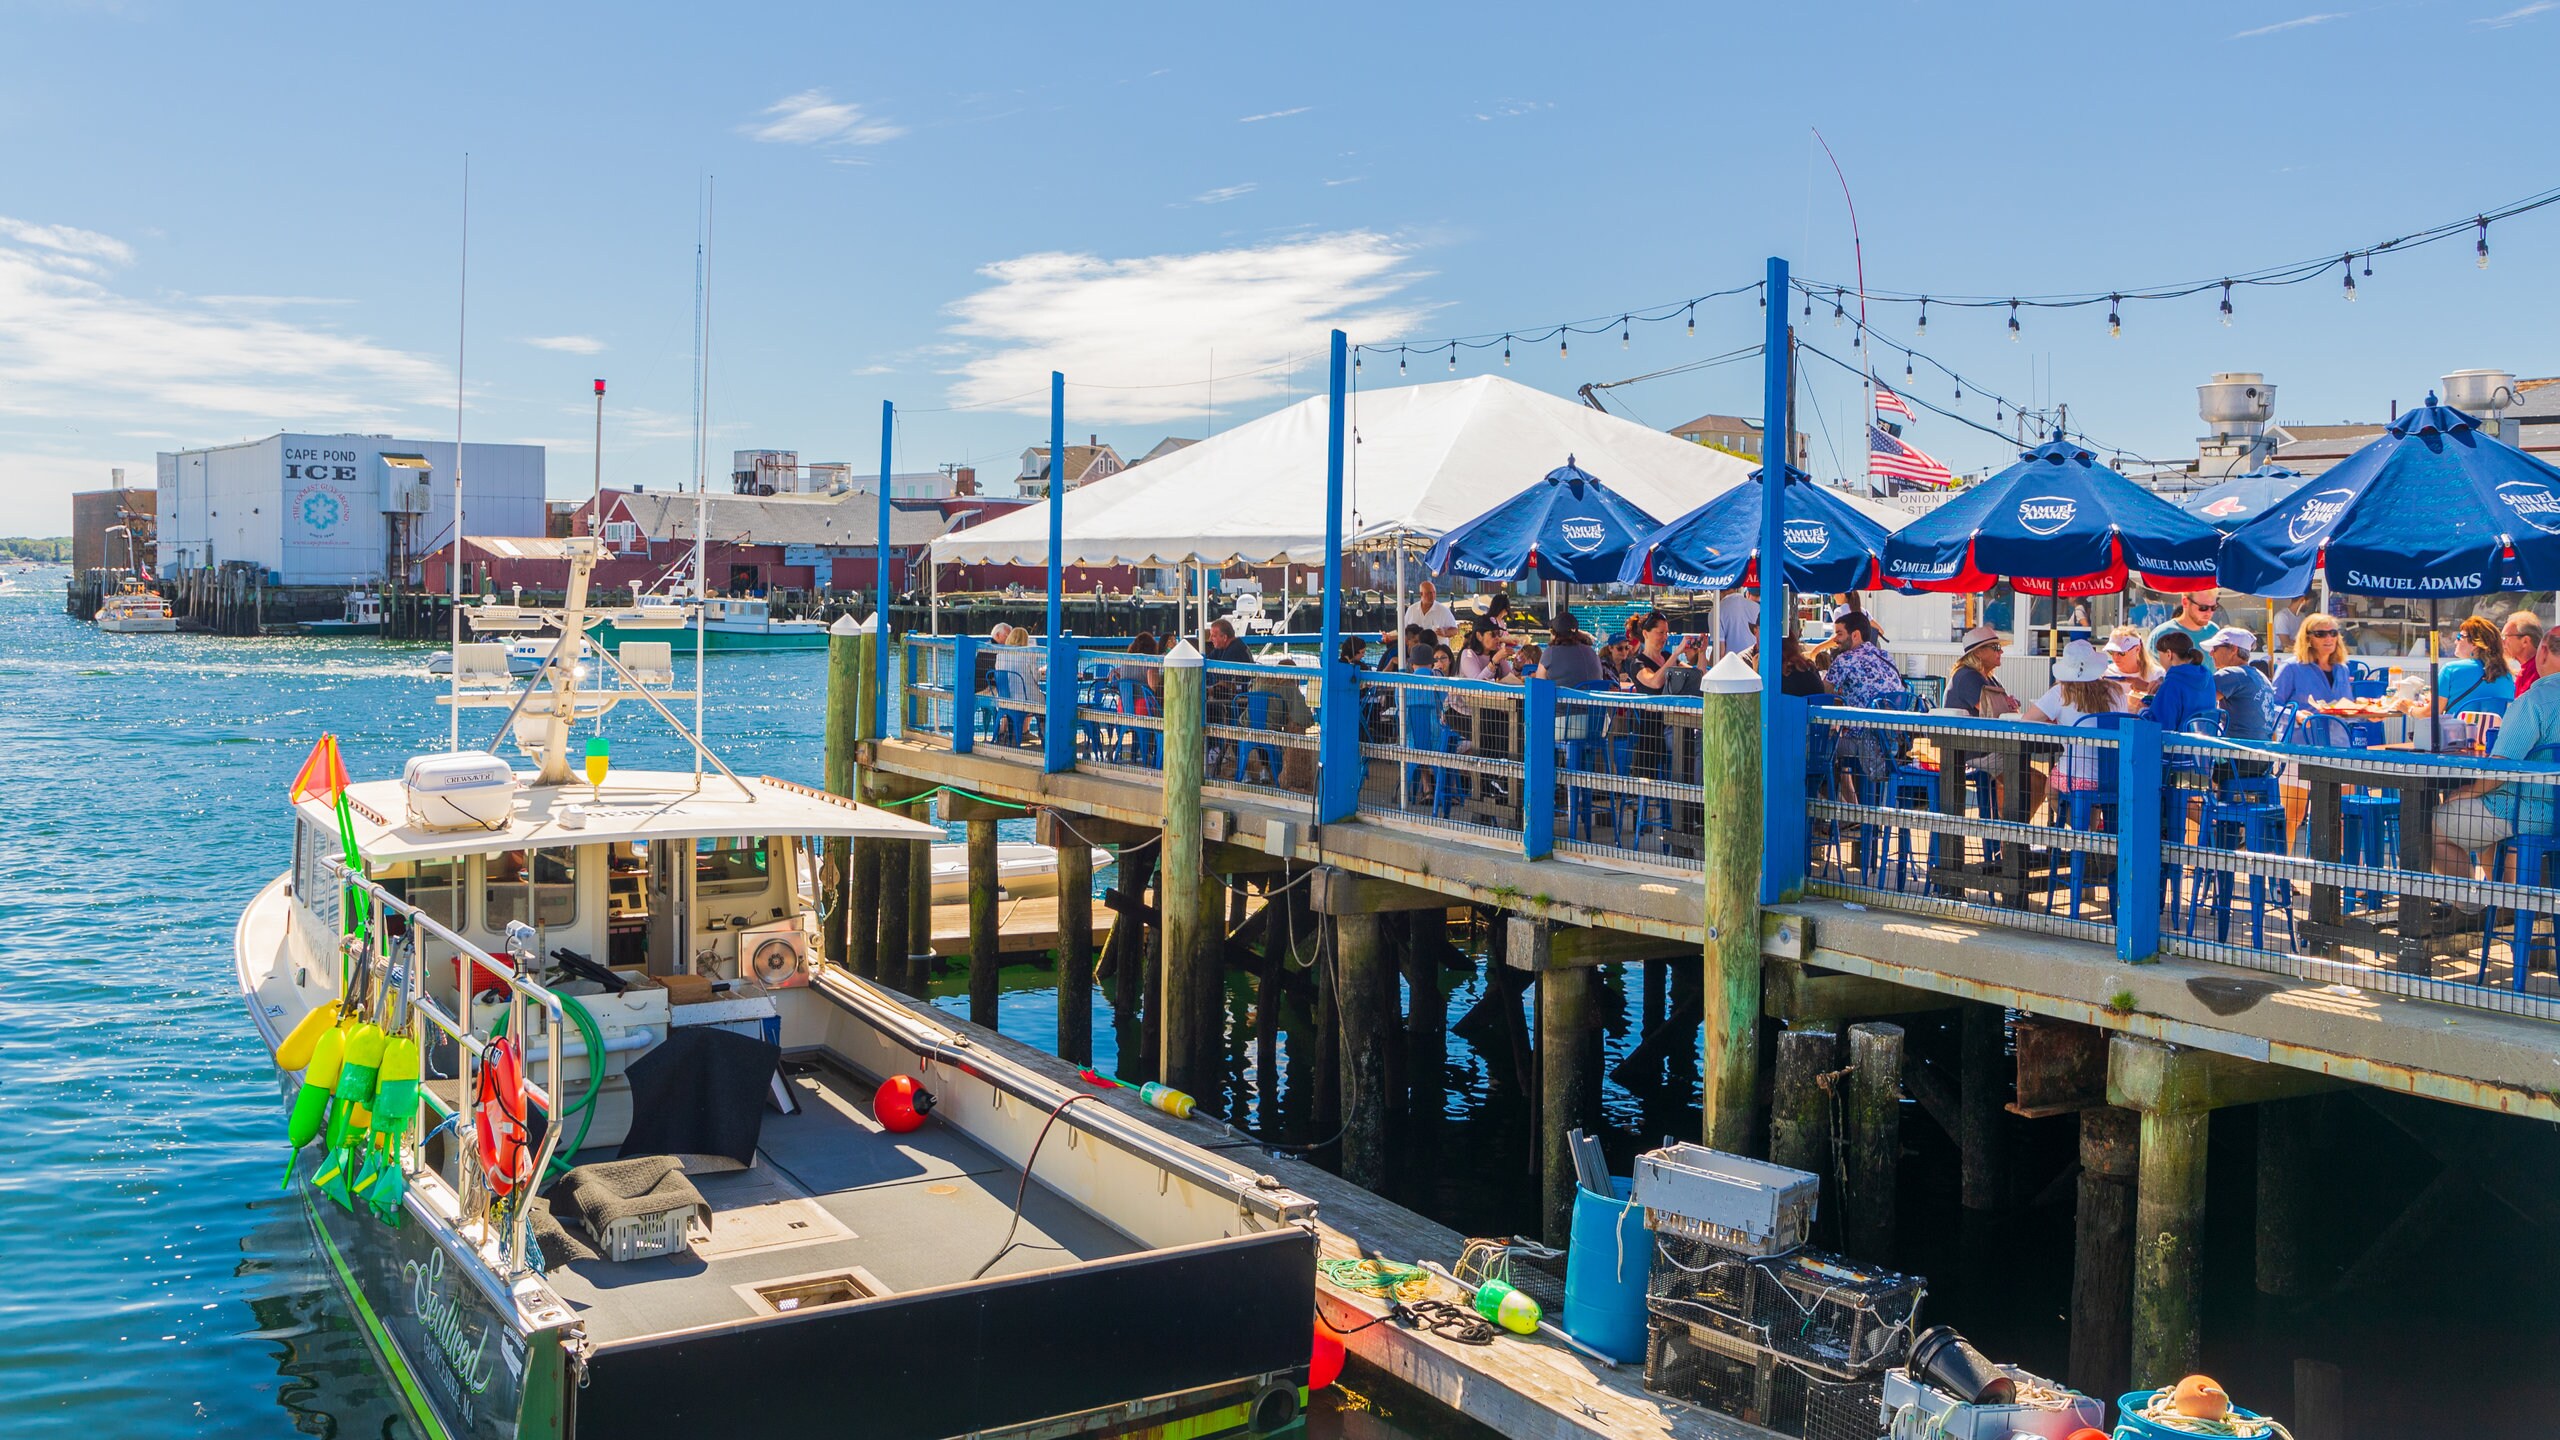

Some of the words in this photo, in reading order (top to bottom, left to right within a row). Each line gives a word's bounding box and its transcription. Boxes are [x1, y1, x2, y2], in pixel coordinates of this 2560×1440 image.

[285, 448, 318, 460] CAPE
[323, 450, 356, 462] POND
[285, 464, 356, 481] ICE
[1900, 494, 1940, 503] ONION
[2499, 491, 2560, 505] SAMUEL
[2019, 503, 2076, 513] SAMUEL
[2022, 511, 2071, 520] ADAMS
[1562, 523, 1605, 533] SAMUEL
[1566, 531, 1602, 539] ADAMS
[1786, 535, 1826, 544] ADAMS
[1454, 560, 1490, 576] SAMUEL
[1890, 559, 1930, 573] SAMUEL
[2136, 553, 2173, 571] SAMUEL
[2173, 558, 2217, 571] ADAMS
[1656, 564, 1700, 584] SAMUEL
[1699, 574, 1735, 586] ADAMS
[2346, 570, 2417, 590] SAMUEL
[2418, 572, 2482, 590] ADAMS
[2068, 576, 2114, 591] ADAMS
[462, 1394, 474, 1428] MA
